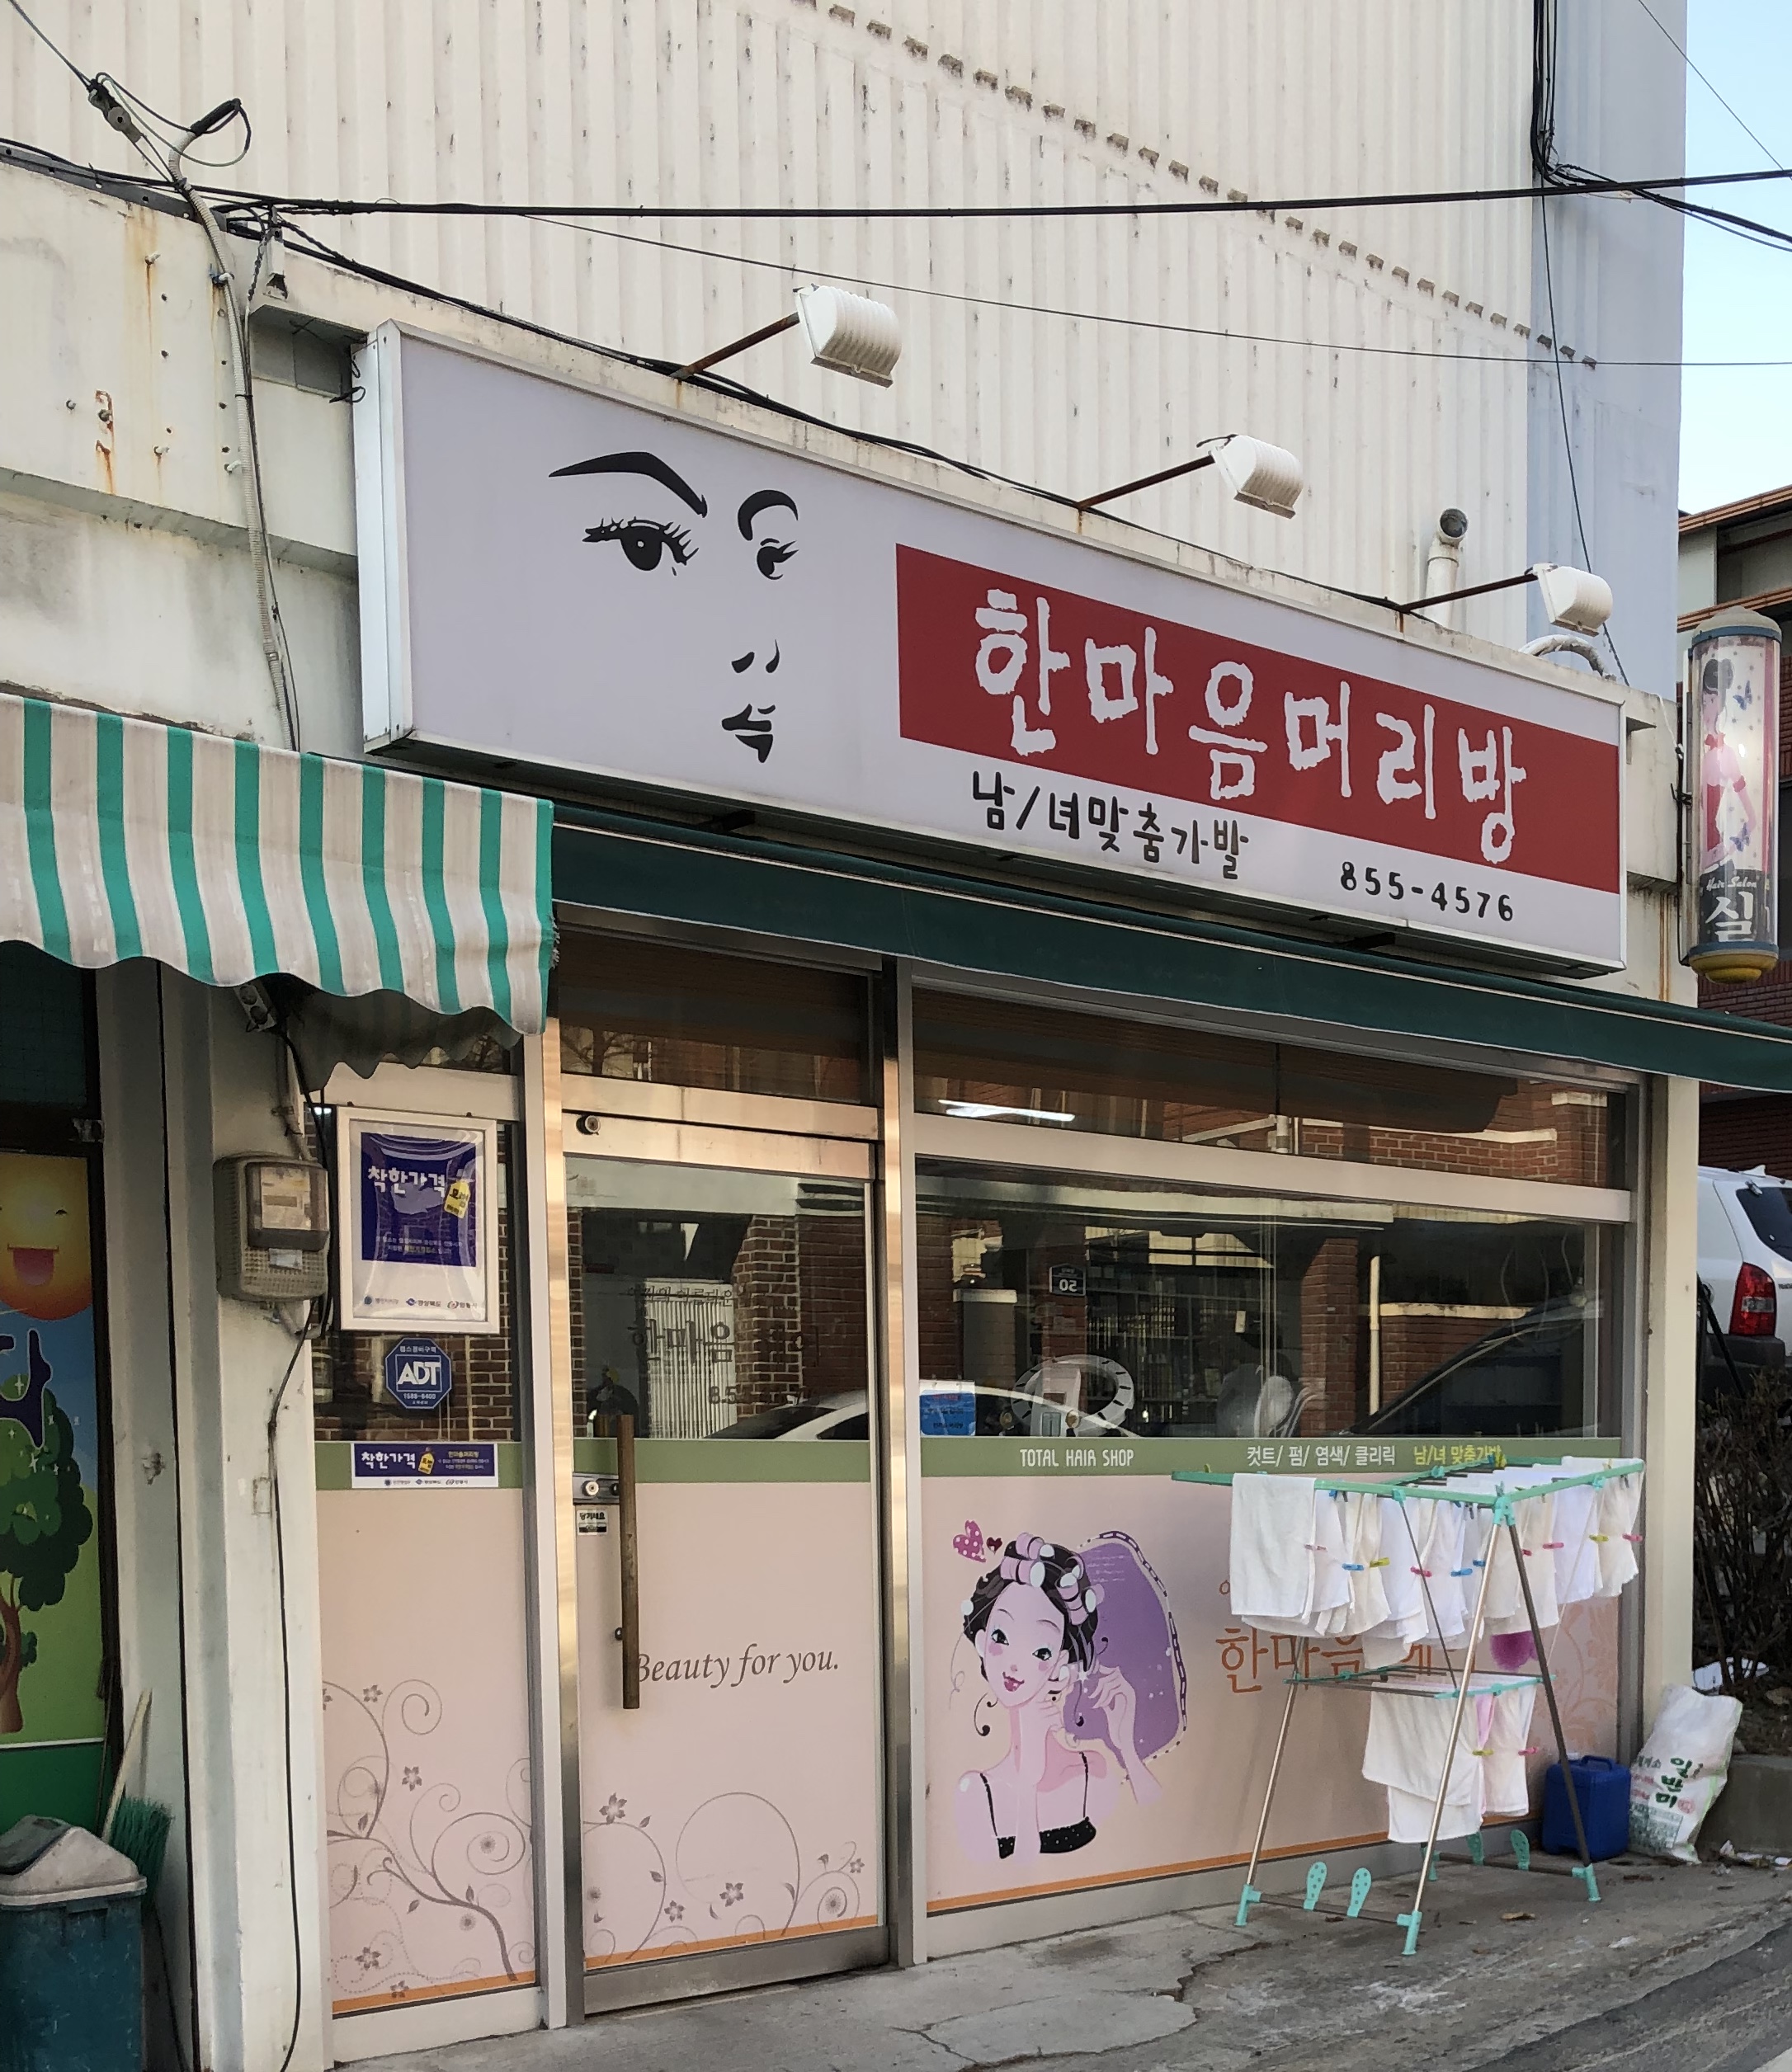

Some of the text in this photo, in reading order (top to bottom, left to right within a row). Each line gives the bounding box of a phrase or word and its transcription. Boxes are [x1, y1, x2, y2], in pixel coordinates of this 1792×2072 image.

[974, 587, 1528, 864] 한마음머리방
[1341, 861, 1514, 922] 855-4576
[1727, 875, 1757, 888] Salon
[1705, 890, 1755, 943] 실
[367, 1165, 446, 1198] 착한가격
[397, 1360, 441, 1386] ADT
[361, 1451, 416, 1470] 착한가격
[1020, 1448, 1134, 1467] TOTAL HAIR SHOP
[1247, 1444, 1284, 1467] 컷트/
[1289, 1444, 1310, 1467] 펌/
[1315, 1444, 1351, 1467] 염색/
[1414, 1444, 1446, 1466] 남/녀
[638, 1643, 839, 1689] Beauty for you.
